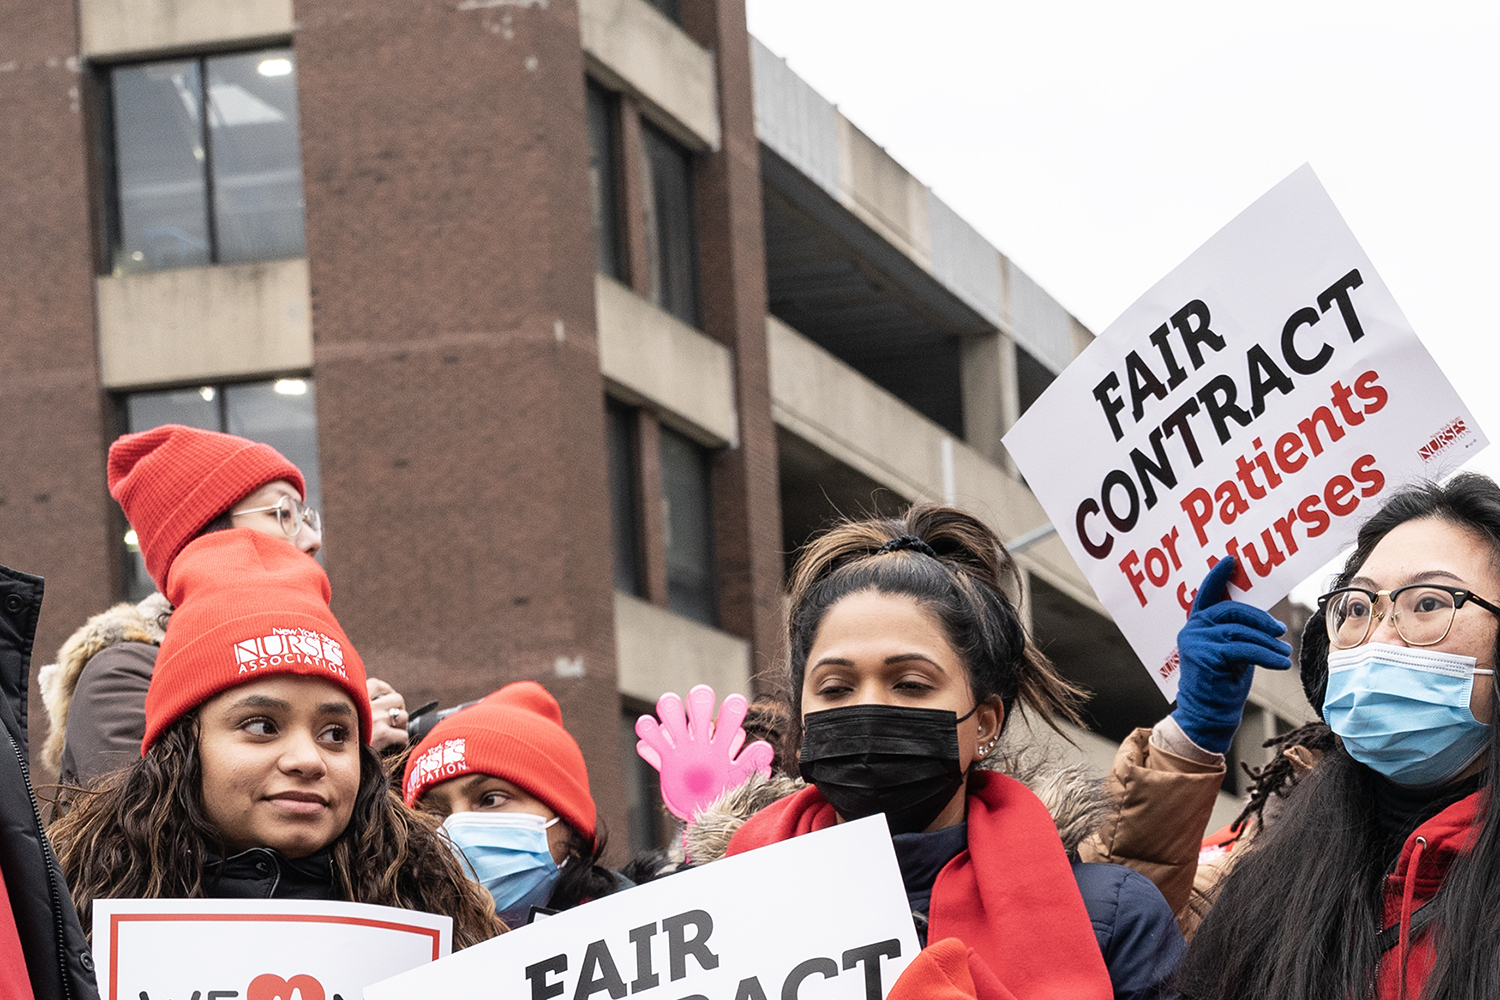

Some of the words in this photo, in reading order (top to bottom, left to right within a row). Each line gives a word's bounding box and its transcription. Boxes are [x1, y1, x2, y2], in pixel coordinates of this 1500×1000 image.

[1076, 268, 1364, 560] CONTRACT
[1092, 298, 1227, 442] FAIR
[1417, 420, 1466, 461] NURSES
[1119, 525, 1179, 608] For
[1180, 370, 1389, 548] Patients
[233, 634, 343, 667] NURSES
[272, 627, 297, 636] New
